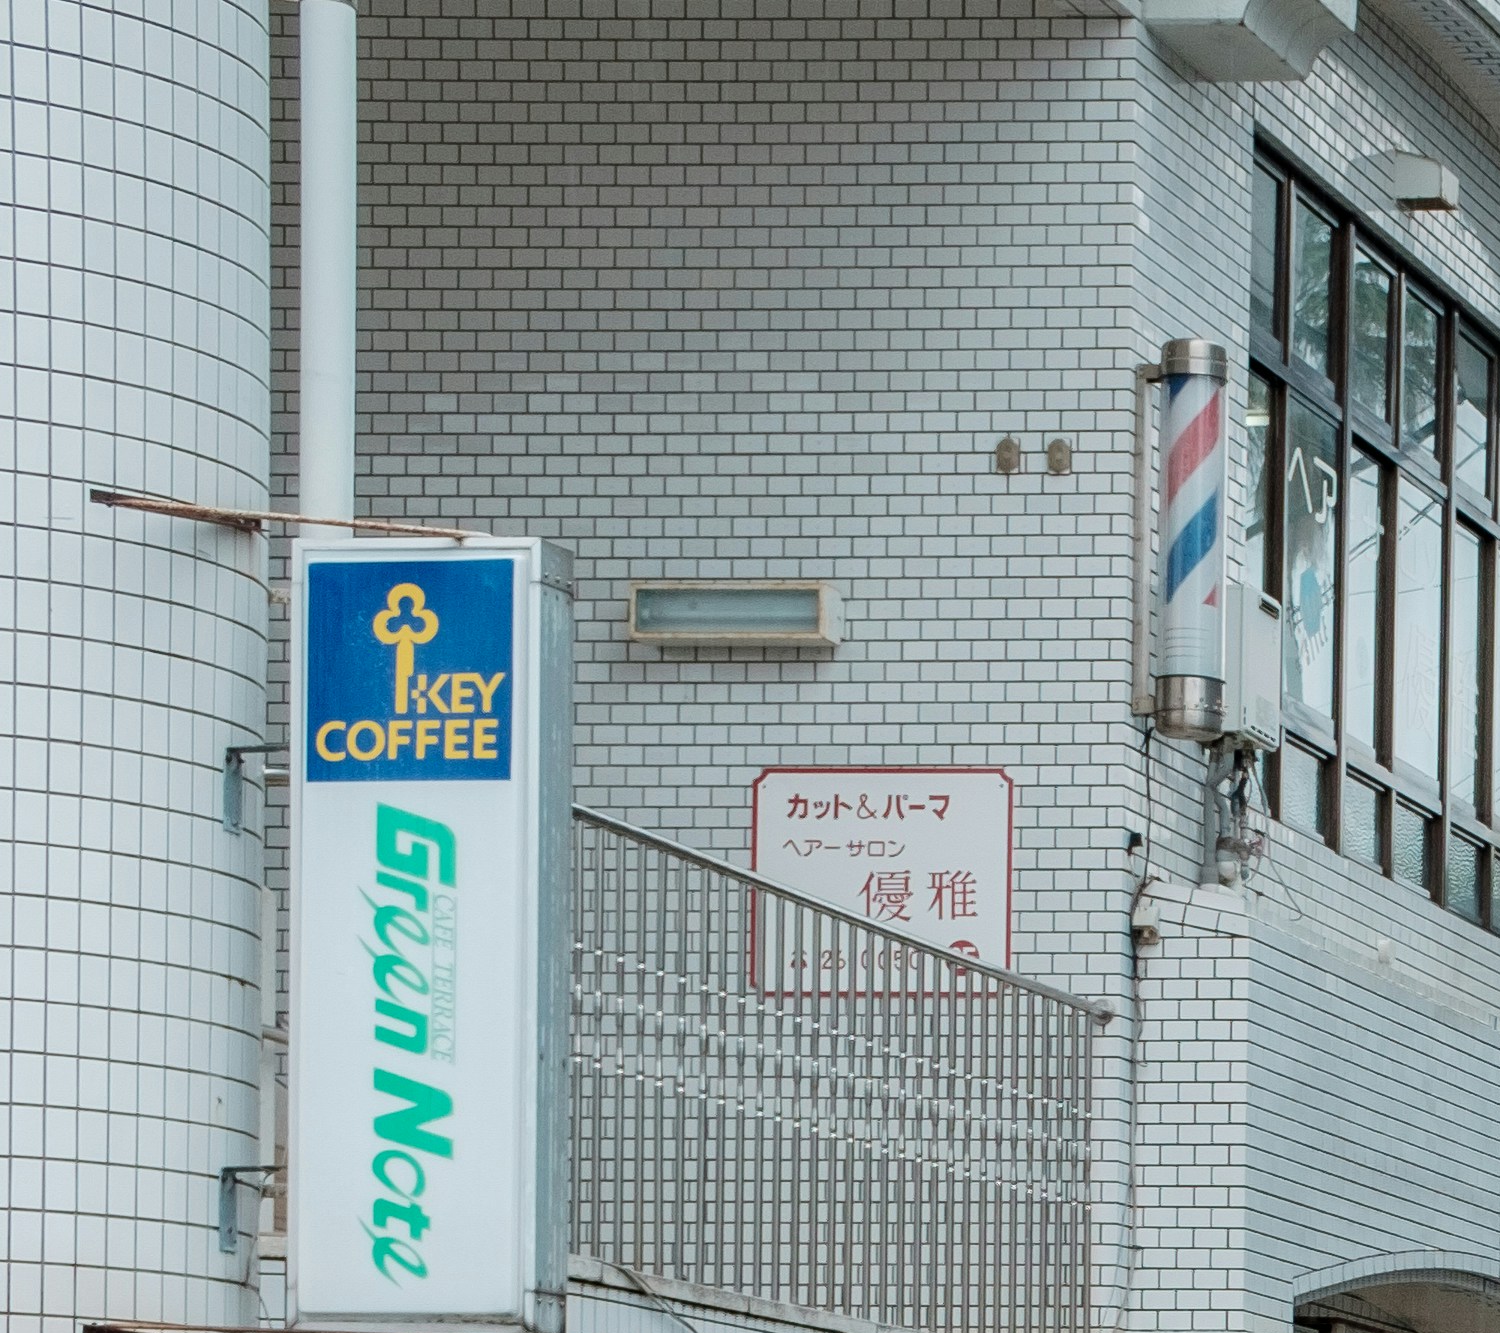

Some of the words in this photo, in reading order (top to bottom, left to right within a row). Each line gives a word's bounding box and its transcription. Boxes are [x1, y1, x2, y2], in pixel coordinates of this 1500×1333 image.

[411, 671, 506, 714] KEY
[315, 718, 499, 763] COFFEE
[786, 792, 951, 822] カット&パーマ
[782, 838, 906, 858] ヘアーサロン
[433, 894, 456, 949] CAFE
[857, 869, 979, 923] 優雅
[357, 802, 458, 1057] Green
[432, 962, 455, 1064] TERRACE
[357, 1066, 455, 1288] Note
